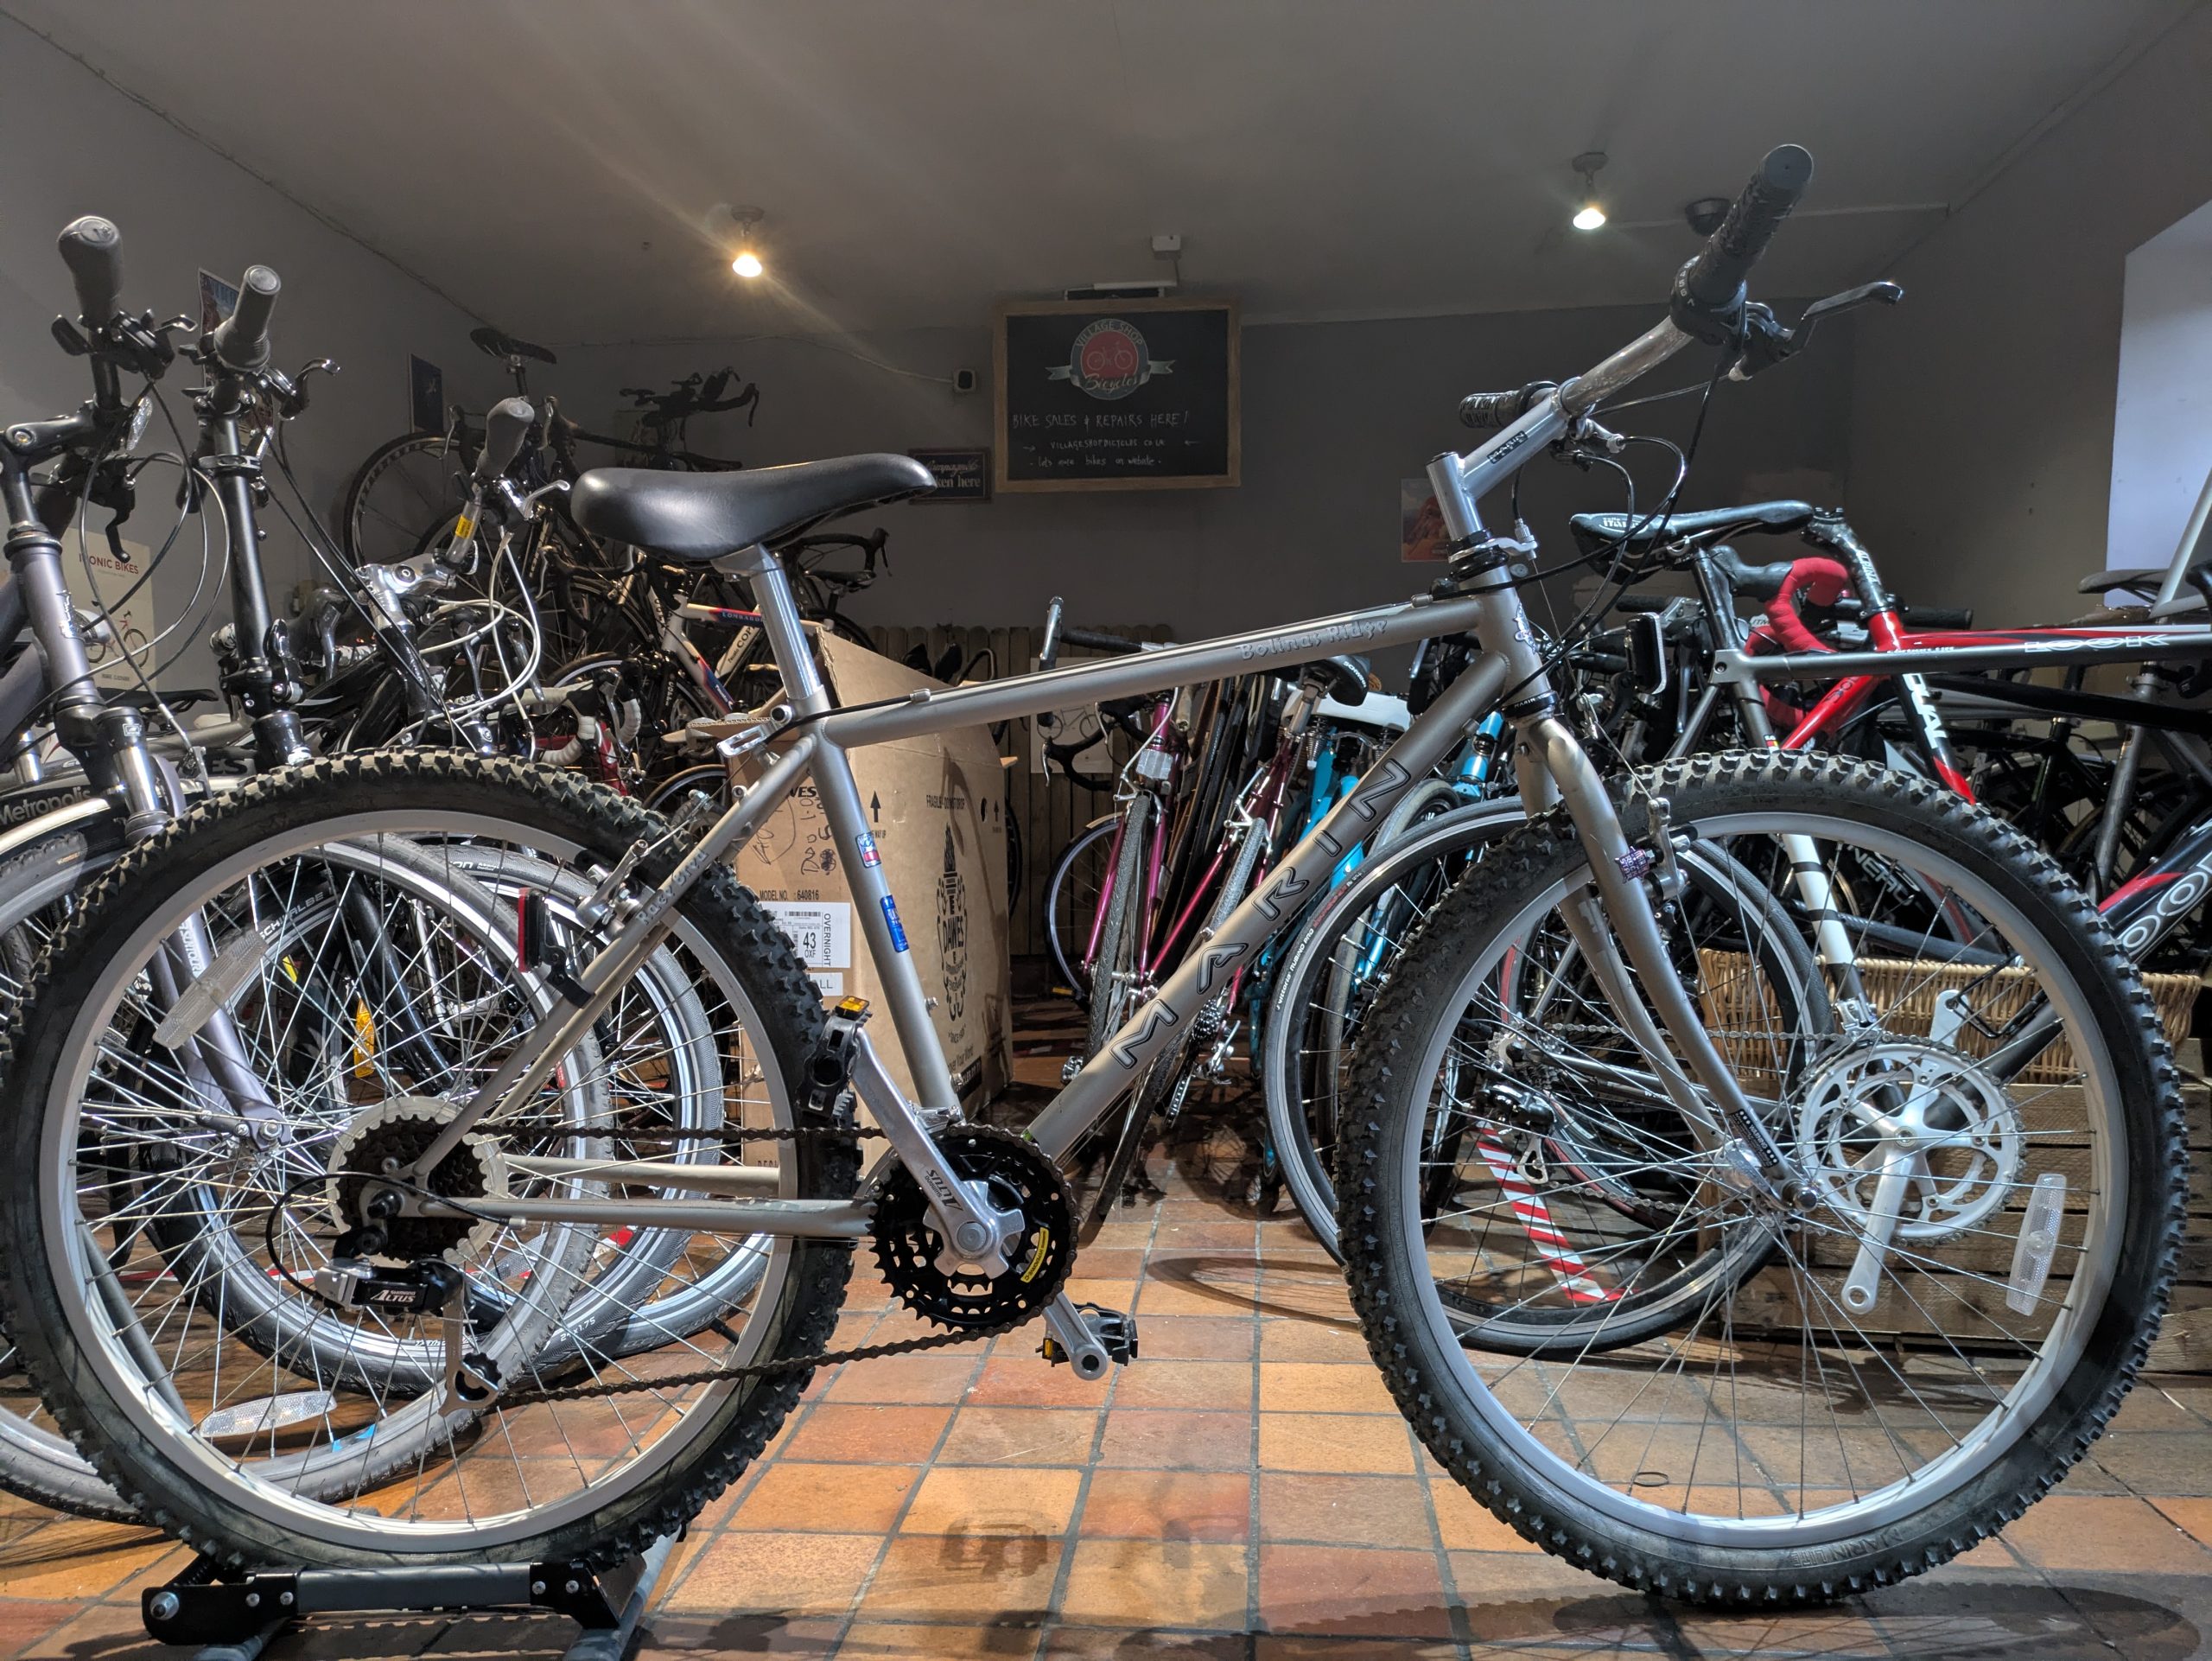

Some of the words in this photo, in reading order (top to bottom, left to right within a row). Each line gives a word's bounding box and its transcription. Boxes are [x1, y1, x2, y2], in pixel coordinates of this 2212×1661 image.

[1077, 321, 1114, 347] VILLAGE
[1120, 323, 1143, 346] SHOP
[1084, 373, 1138, 394] Bicycles
[1012, 414, 1038, 429] BIKE
[1046, 414, 1077, 429] SALES
[1096, 413, 1142, 429] REPAIRS
[1489, 432, 1524, 460] MARIN
[1085, 455, 1106, 466] bikes
[958, 475, 981, 487] here
[79, 553, 112, 570] IONIC
[115, 561, 139, 575] BIKES
[736, 626, 757, 649] COP
[1237, 636, 1322, 660] Bolinas
[1326, 620, 1388, 643] Ridge
[2024, 634, 2170, 653] LOOK
[1903, 672, 1948, 749] DUAL
[760, 890, 778, 901] MODEL
[797, 889, 819, 901] 640816
[1109, 758, 1411, 1070] MARIN
[803, 932, 817, 949] 43
[943, 915, 964, 953] DAWES
[1303, 928, 1314, 944] PRO
[804, 949, 817, 958] OXF
[819, 979, 833, 990] LL
[1748, 1123, 1769, 1149] WARNING
[926, 1169, 964, 1212] ALTUS
[370, 1289, 416, 1302] ALTUS
